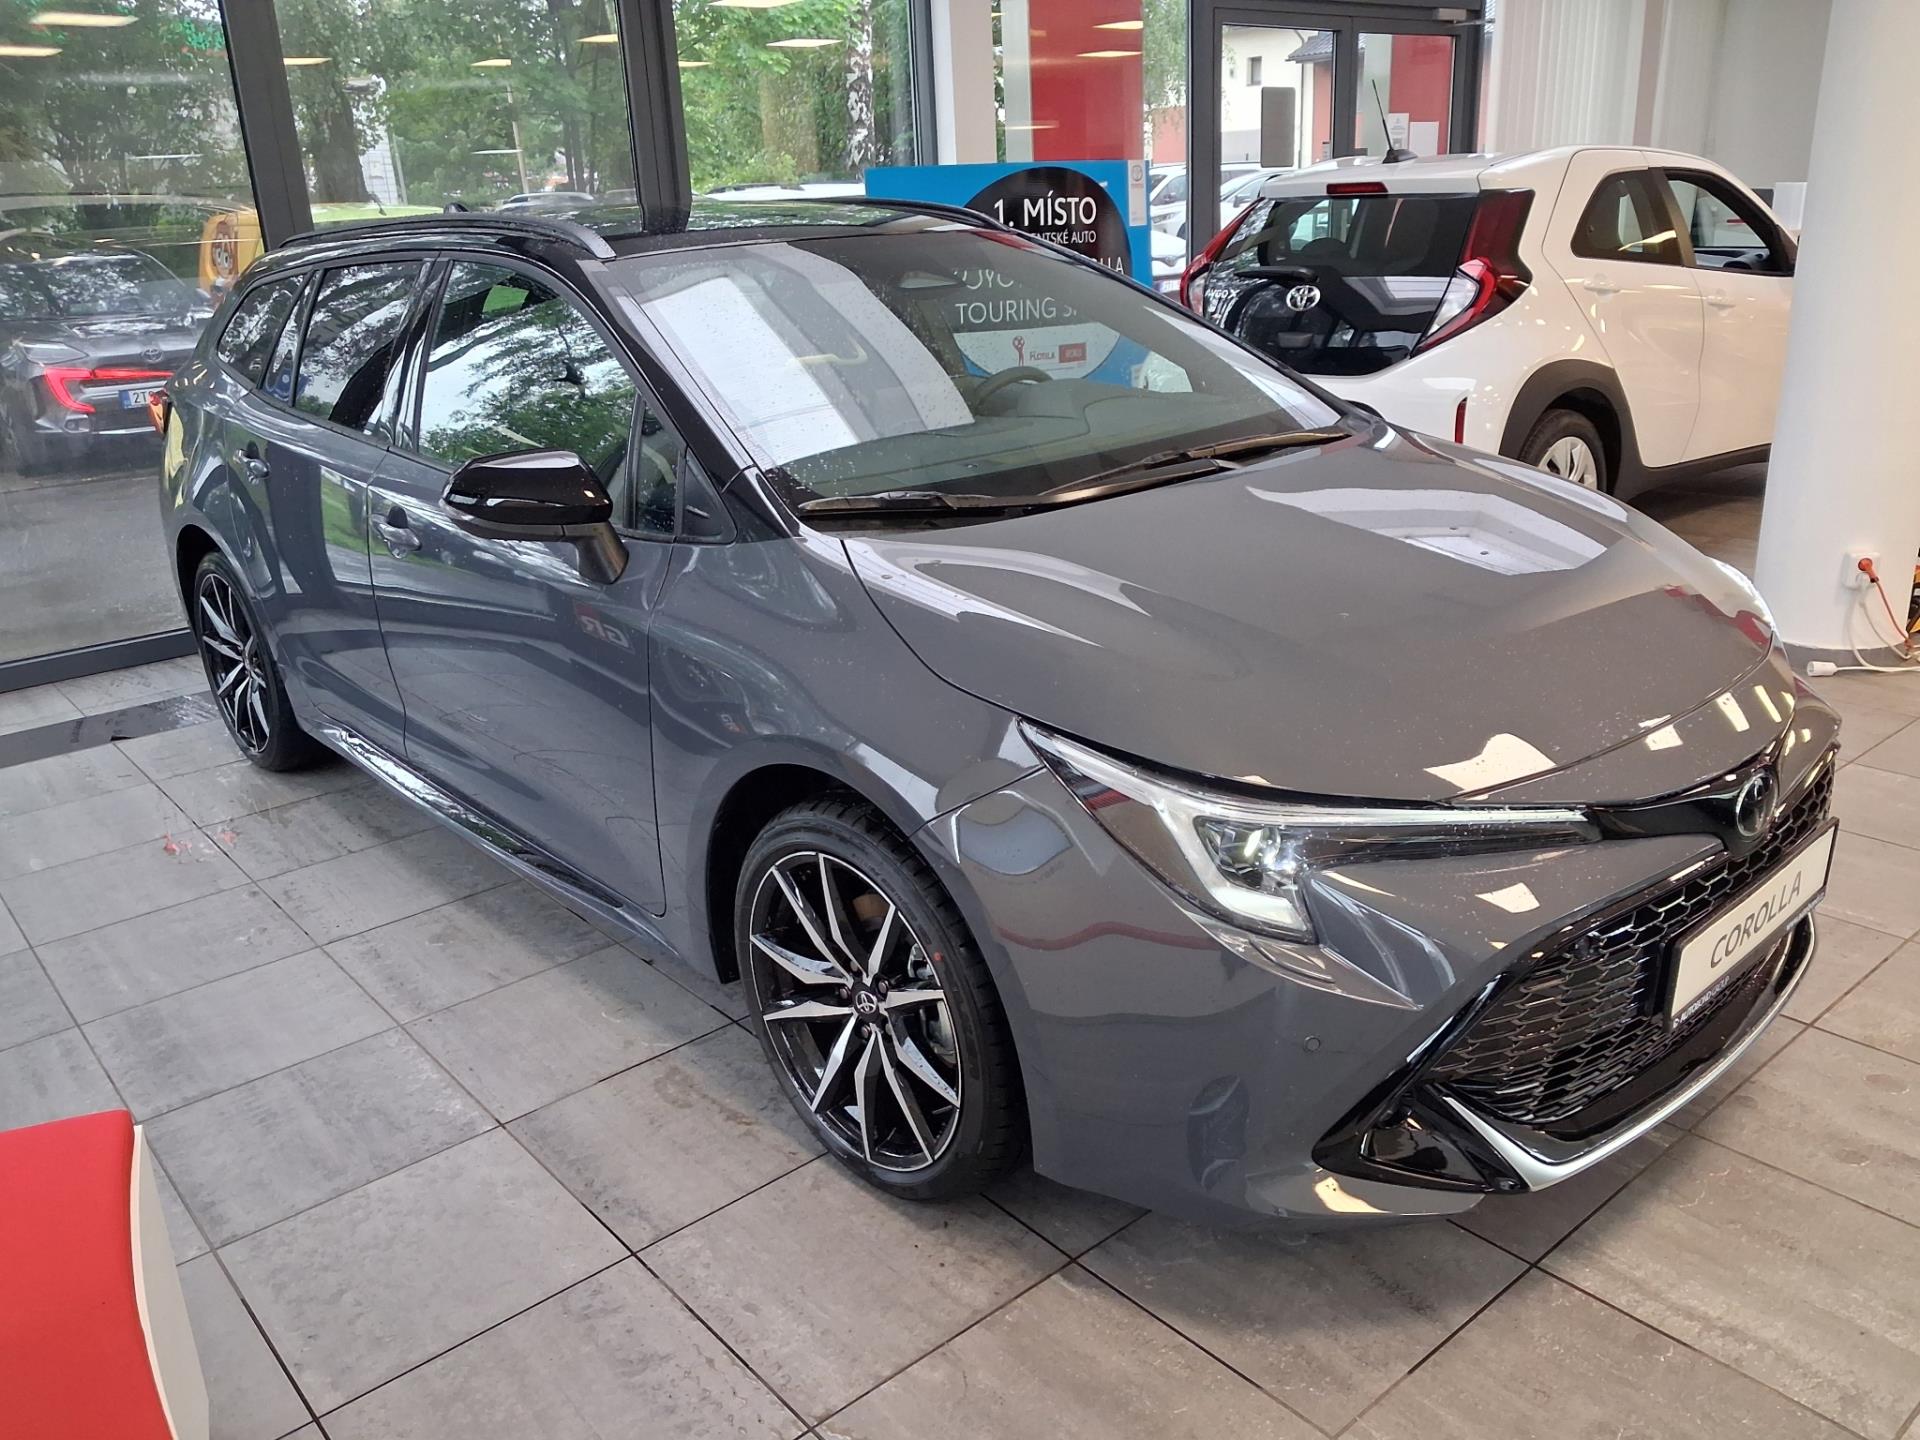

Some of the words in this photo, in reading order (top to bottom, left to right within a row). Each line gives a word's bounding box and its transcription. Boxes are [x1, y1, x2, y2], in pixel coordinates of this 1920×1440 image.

[994, 198, 1014, 228] 1.
[1023, 189, 1097, 227] MÍSTO
[1071, 230, 1097, 244] AUTO
[954, 296, 1057, 325] TOURING
[1710, 870, 1802, 969] COROLLA
